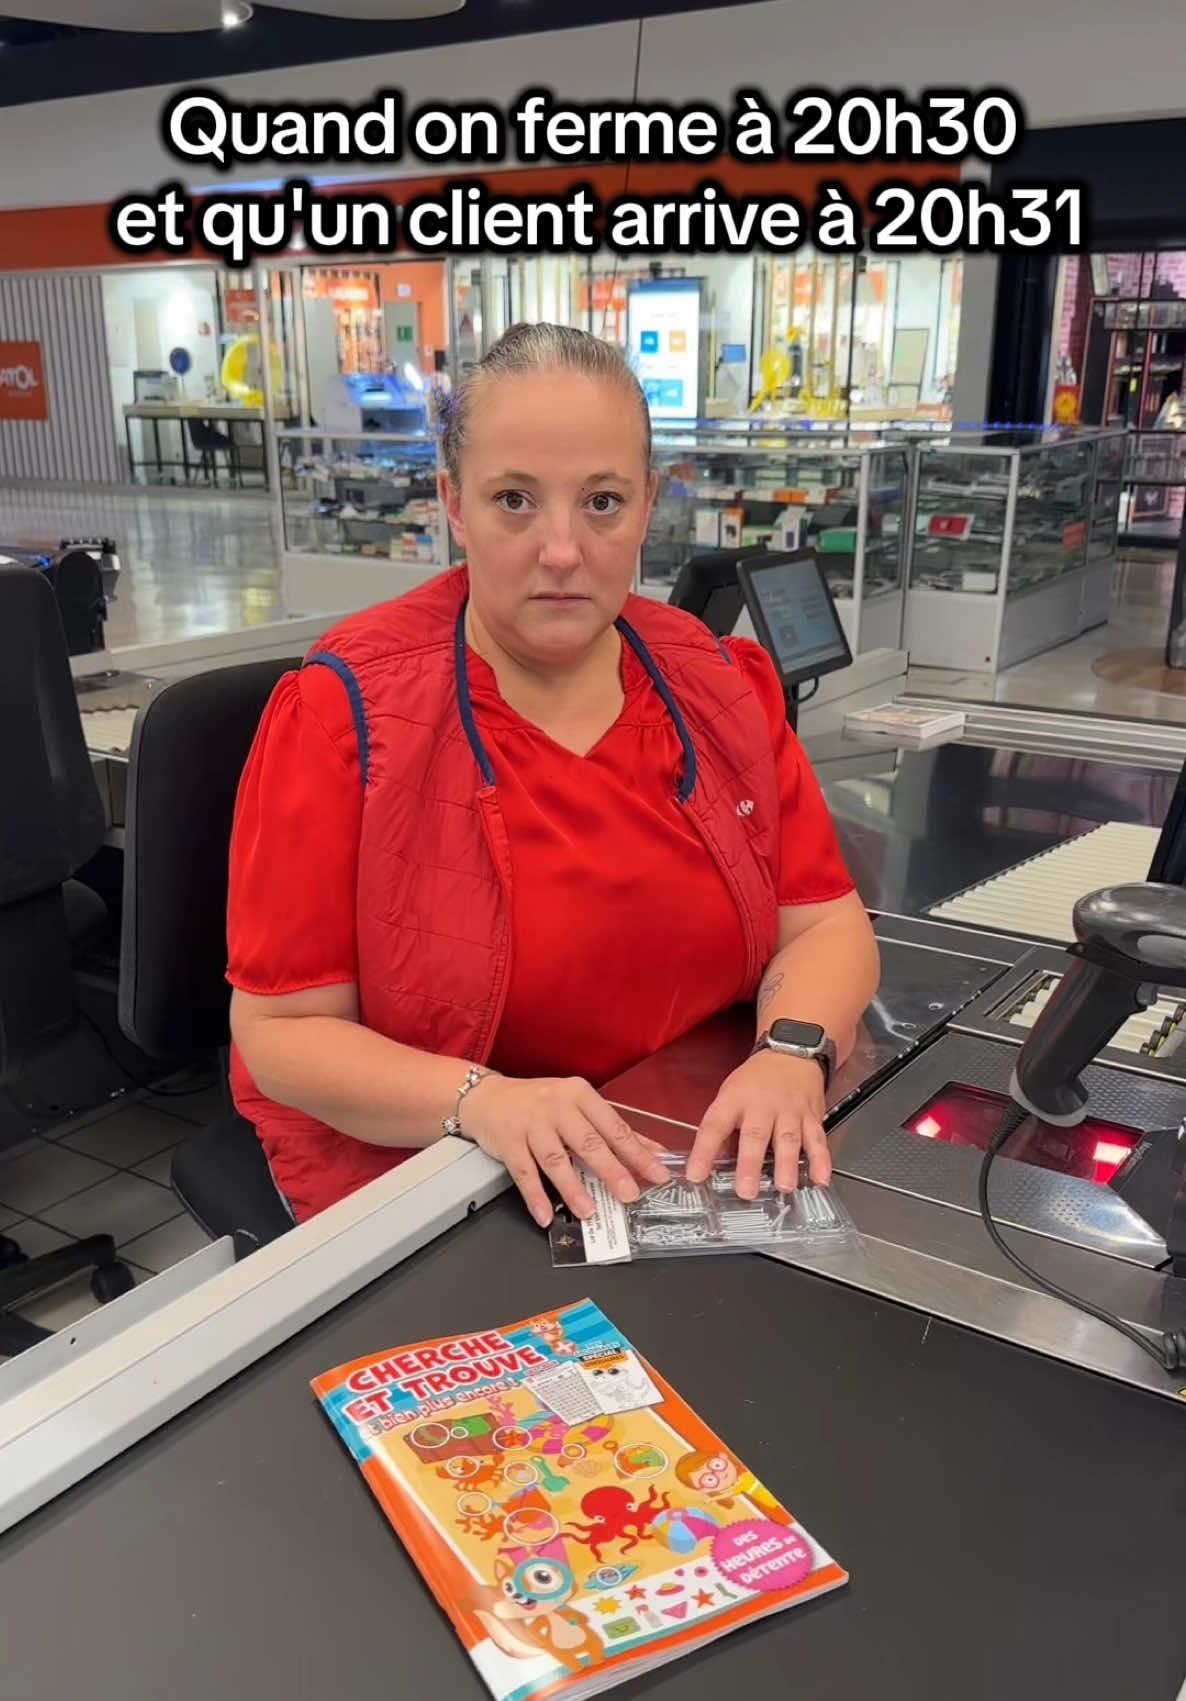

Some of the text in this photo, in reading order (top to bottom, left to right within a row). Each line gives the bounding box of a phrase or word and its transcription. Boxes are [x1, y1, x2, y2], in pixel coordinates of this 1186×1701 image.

[344, 1345, 547, 1423] ET TROUVE
[347, 1331, 513, 1392] CHERCHE
[380, 1411, 418, 1431] bien
[418, 1396, 456, 1417] plus
[456, 1381, 510, 1402] encore
